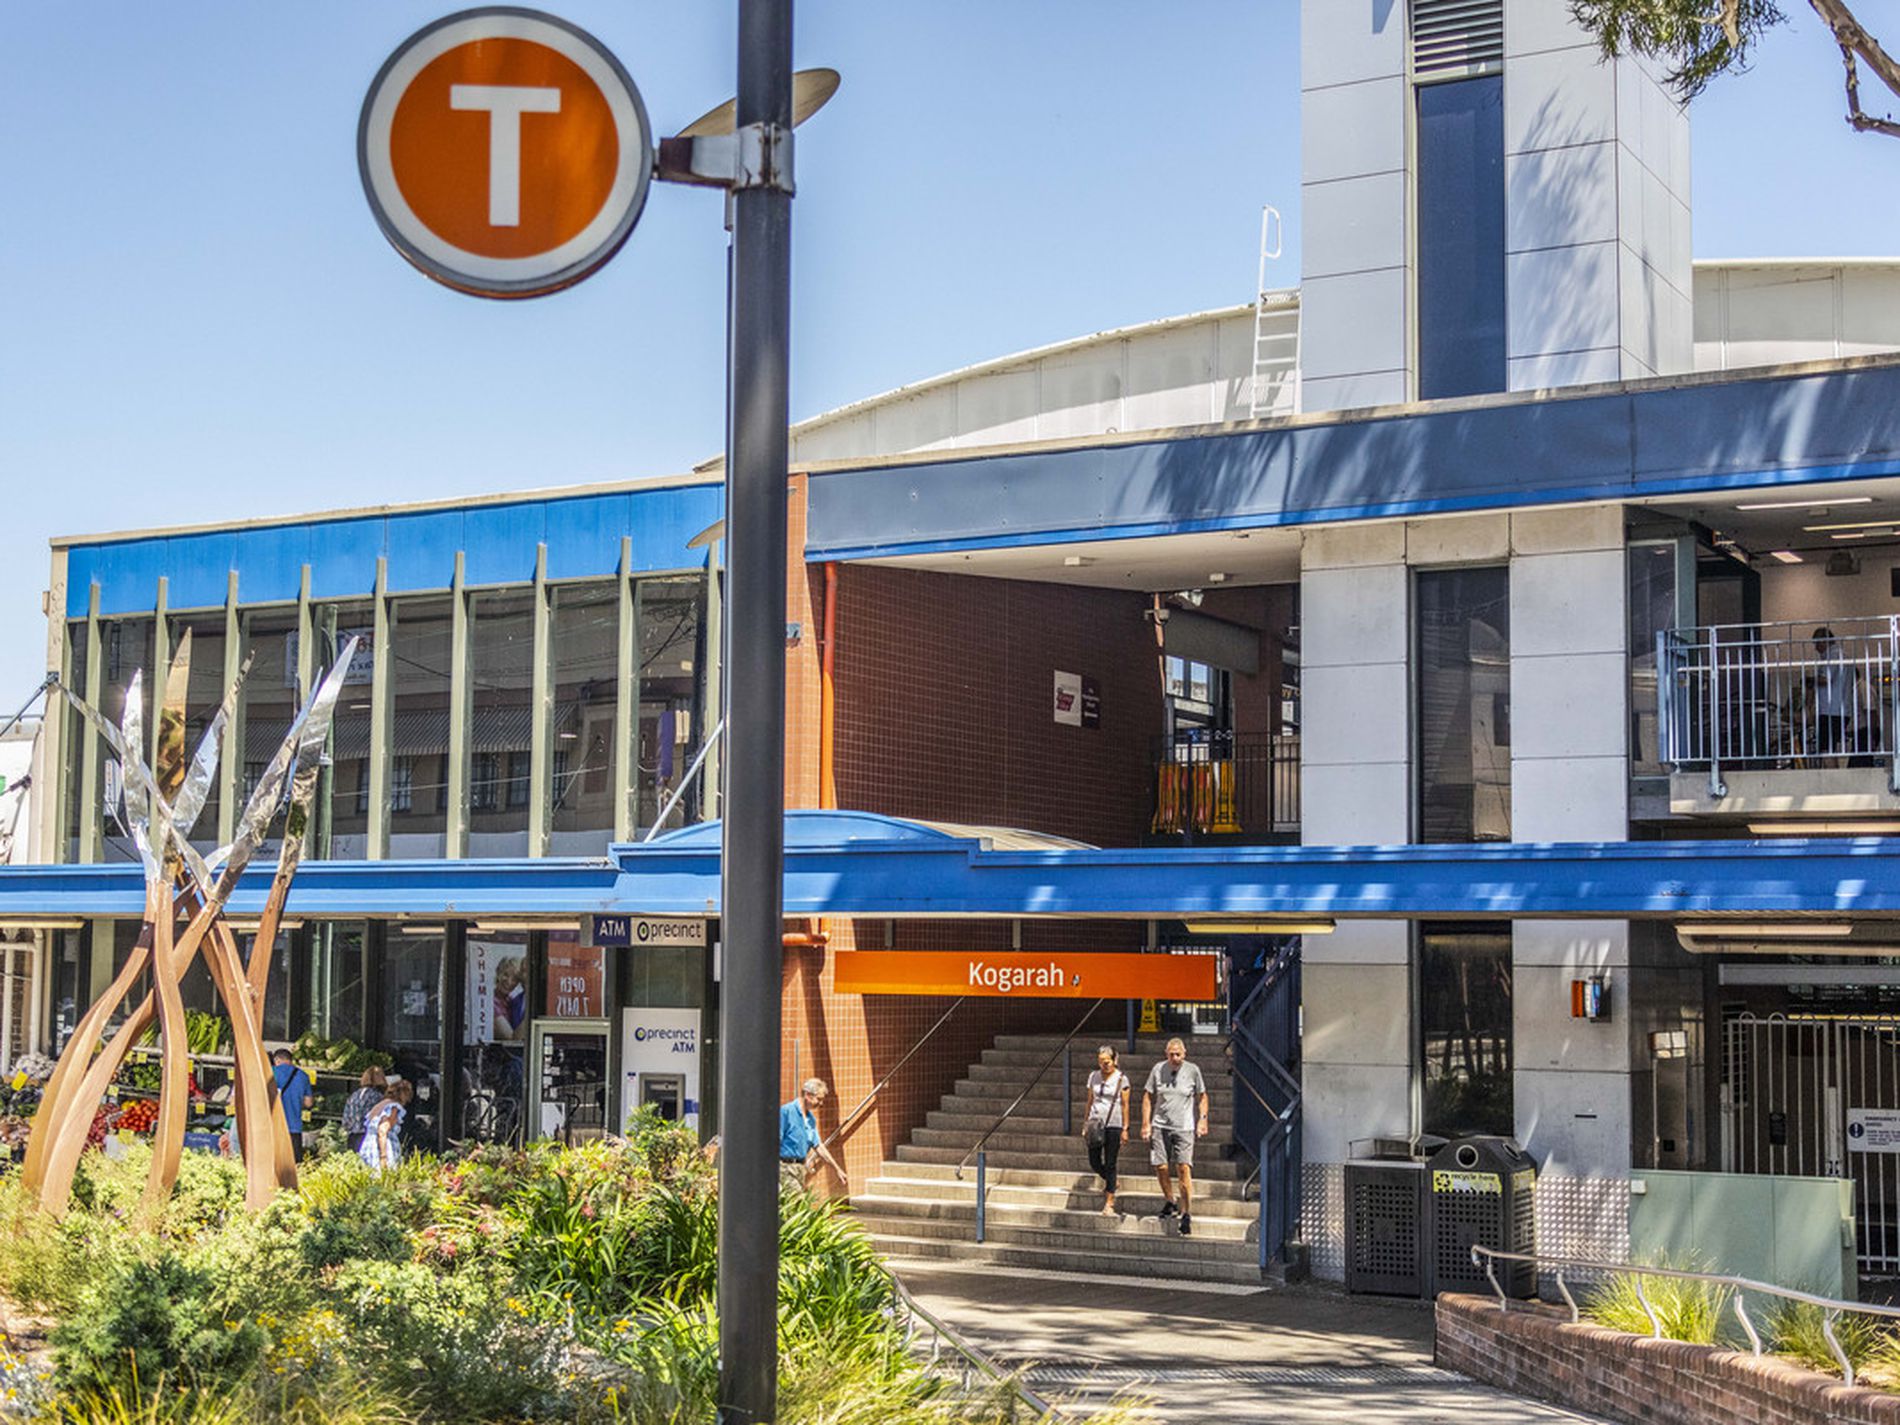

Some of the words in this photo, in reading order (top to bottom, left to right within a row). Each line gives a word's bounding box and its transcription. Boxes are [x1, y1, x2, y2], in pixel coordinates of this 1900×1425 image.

[450, 84, 561, 227] T
[599, 920, 626, 937] ATM
[650, 922, 701, 941] precinct
[968, 961, 1064, 993] Kogarah
[647, 1028, 696, 1042] precinct
[671, 1041, 696, 1053] ATM
